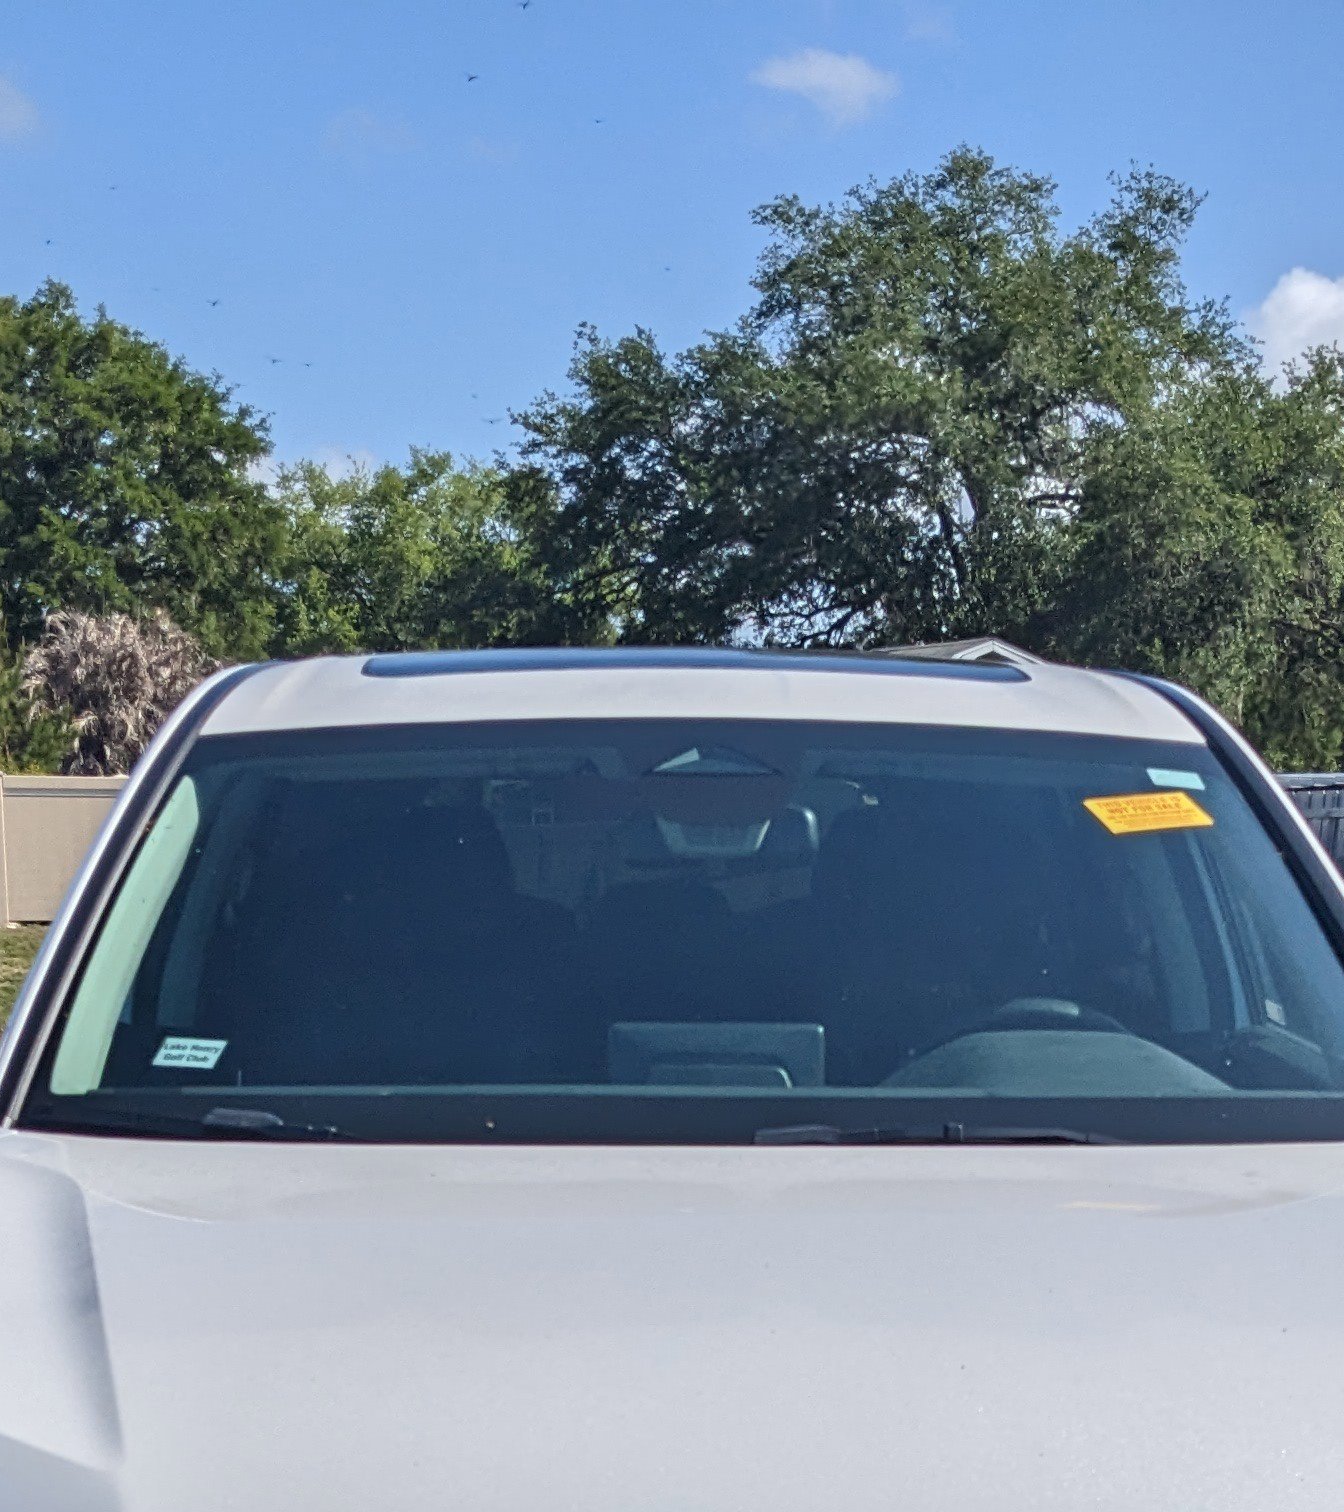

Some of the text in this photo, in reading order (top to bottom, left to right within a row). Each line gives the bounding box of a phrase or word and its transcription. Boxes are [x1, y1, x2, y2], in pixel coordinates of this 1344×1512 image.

[1107, 802, 1182, 814] NOT FOR SALE
